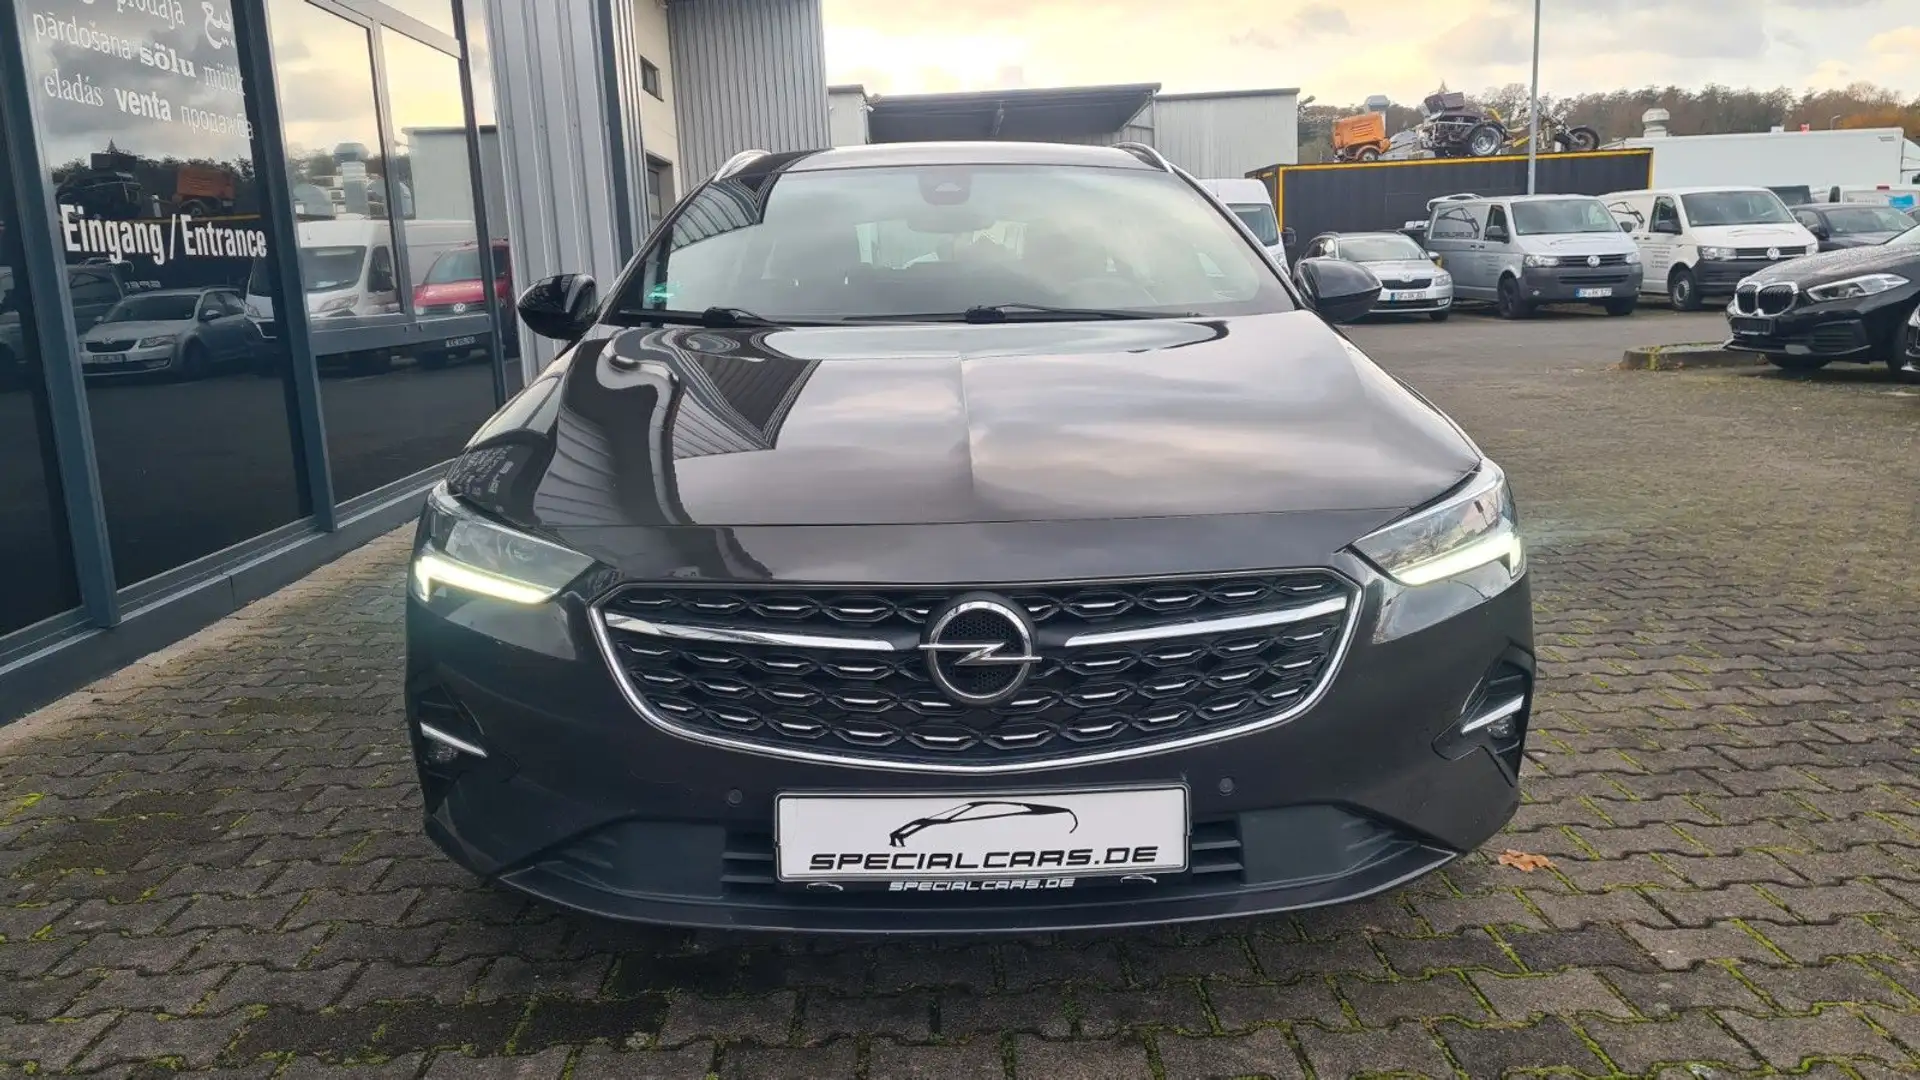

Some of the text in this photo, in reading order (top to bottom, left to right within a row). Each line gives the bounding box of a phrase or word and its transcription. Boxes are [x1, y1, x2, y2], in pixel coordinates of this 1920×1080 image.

[33, 12, 132, 60] pārdošana
[139, 43, 196, 78] sölu
[44, 68, 172, 122] eladás venta
[809, 846, 1159, 871] SPECIALCARS.DE
[889, 878, 1075, 892] SPECIALCARS.DE
